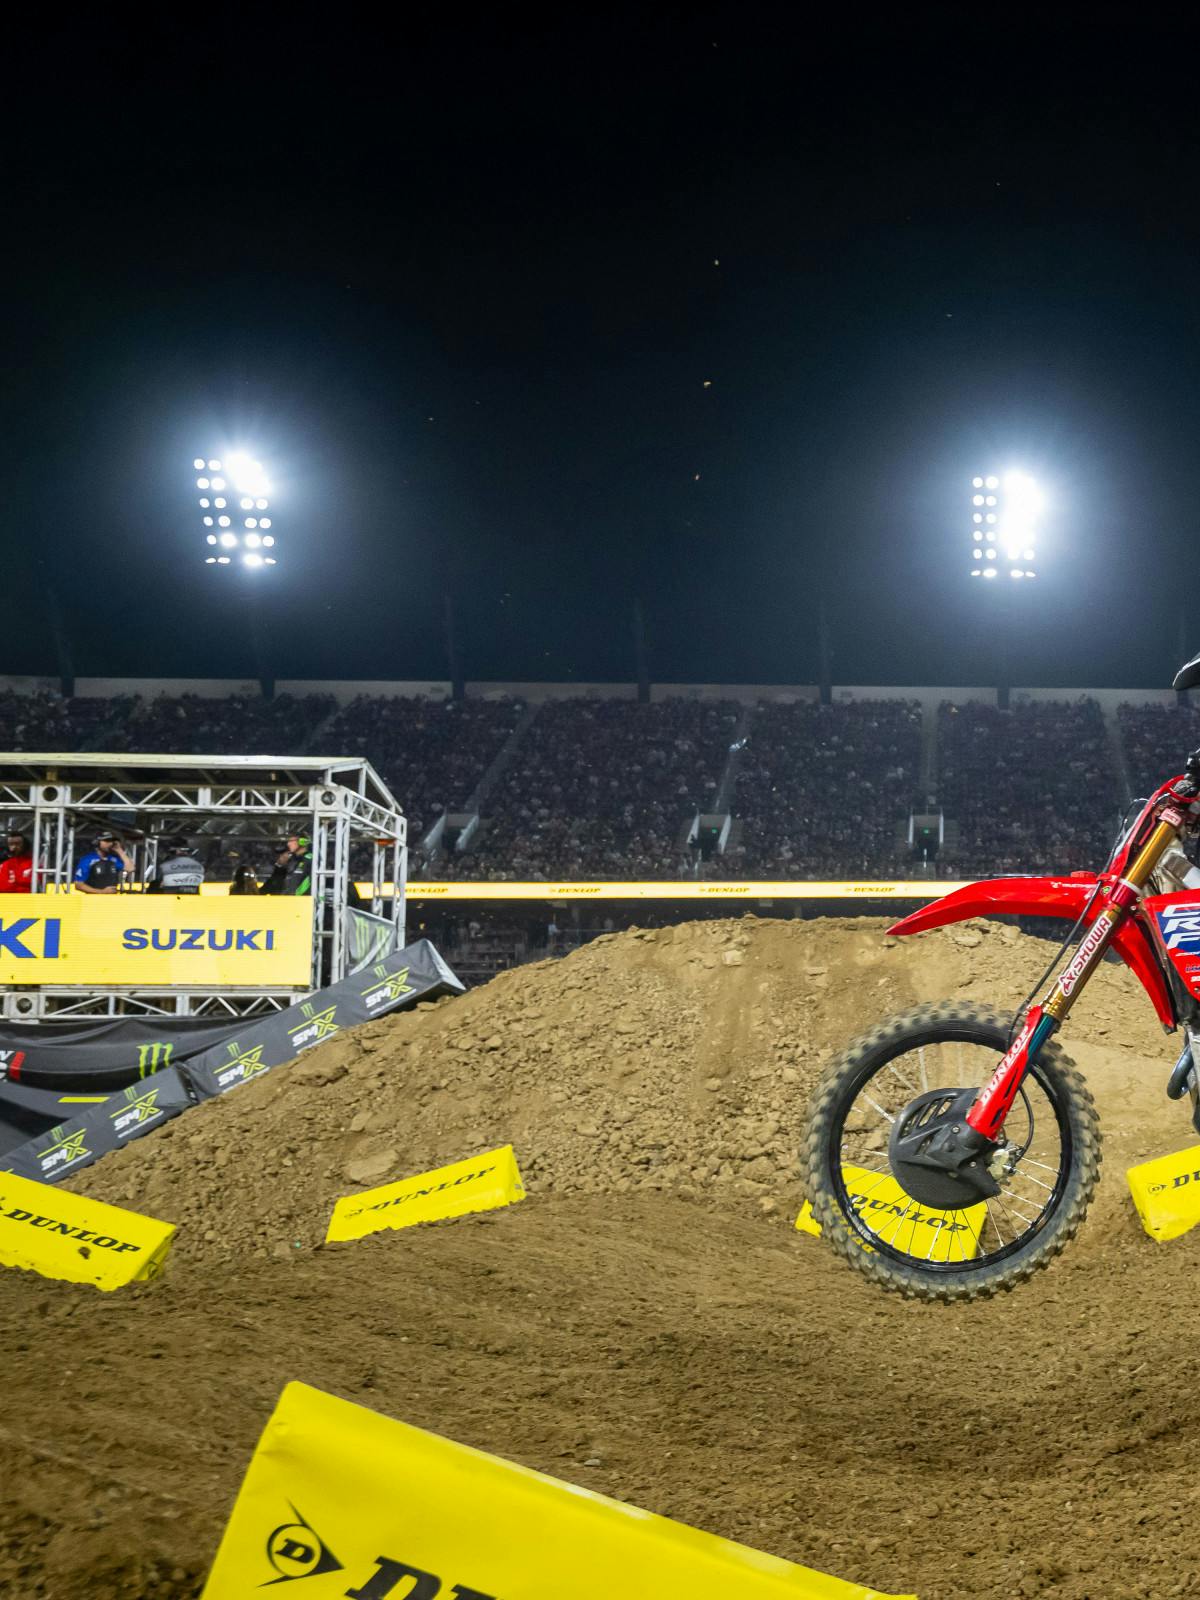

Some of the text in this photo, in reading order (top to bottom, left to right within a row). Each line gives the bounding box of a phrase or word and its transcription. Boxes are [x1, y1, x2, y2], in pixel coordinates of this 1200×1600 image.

[122, 928, 274, 950] SUZUKI
[1074, 916, 1110, 972] SHOWA
[365, 970, 412, 1008] SMX
[292, 1010, 340, 1047] SMX
[218, 1050, 266, 1086] SMX
[981, 1025, 1029, 1104] DUNLOP
[114, 1094, 160, 1131] SMX
[41, 1134, 88, 1171] SMX
[366, 1166, 496, 1210] DUNLOP
[4, 1208, 142, 1254] DUNLOP
[851, 1192, 968, 1232] DUNLOP
